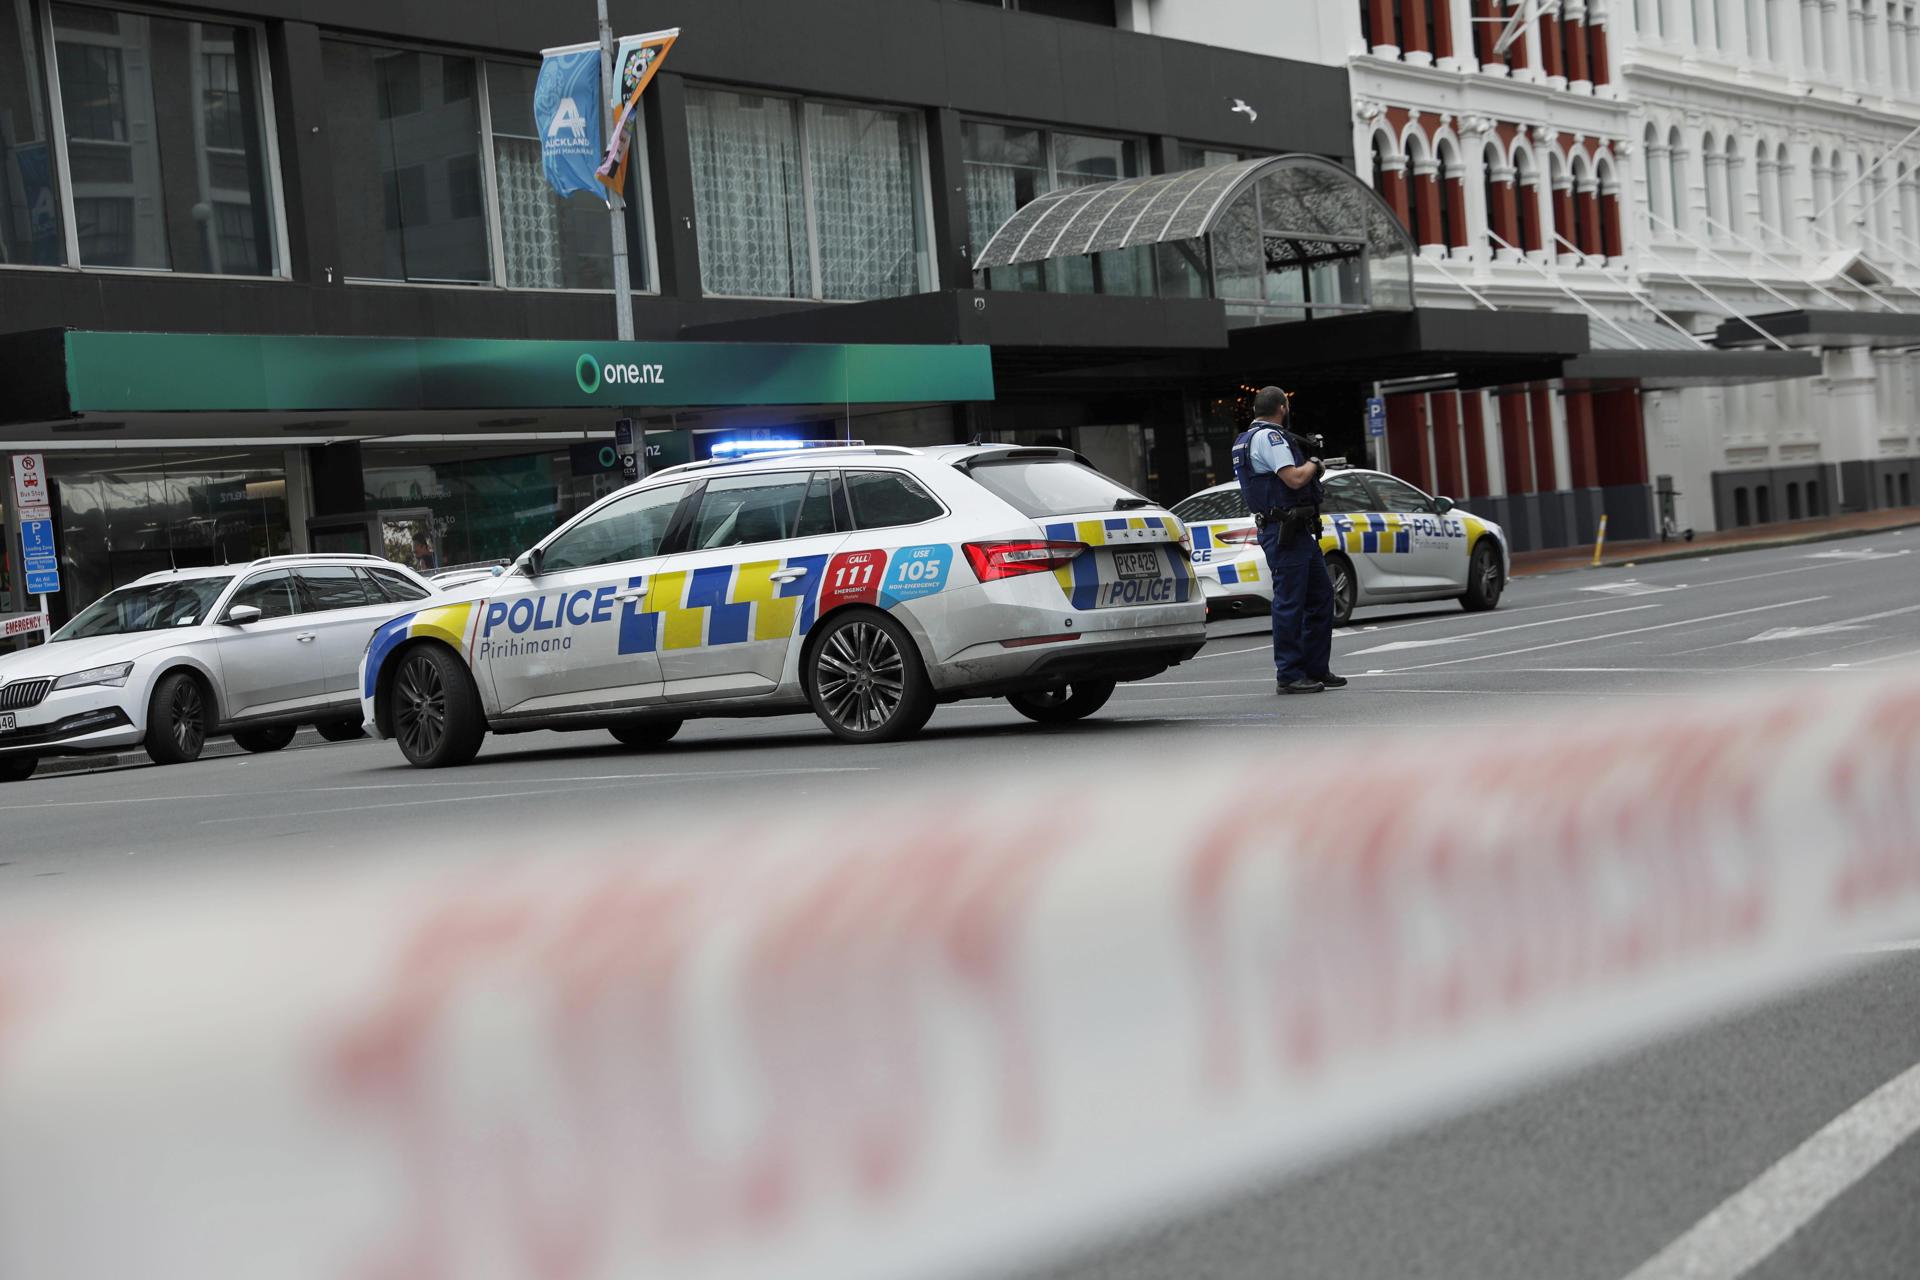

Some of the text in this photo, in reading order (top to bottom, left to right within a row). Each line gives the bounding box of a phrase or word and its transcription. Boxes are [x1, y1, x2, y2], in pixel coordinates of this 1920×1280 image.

[545, 138, 590, 148] AUCKLAND
[604, 364, 664, 384] one.nz
[1371, 404, 1381, 418] P
[32, 490, 45, 498] Stop
[31, 522, 41, 534] P
[1412, 518, 1462, 537] POLICE
[35, 535, 41, 544] 5
[849, 555, 868, 564] CALL
[913, 550, 929, 559] USE
[1117, 553, 1156, 572] PKP429
[835, 564, 874, 587] 111
[898, 559, 941, 582] 105
[834, 586, 867, 595] EMERGENCY
[889, 582, 940, 590] NON-EMERGENCY
[1110, 578, 1172, 604] POLICE
[483, 586, 617, 638] POLICE
[5, 615, 41, 635] EMERGENCY
[480, 637, 572, 660] Pirihimana
